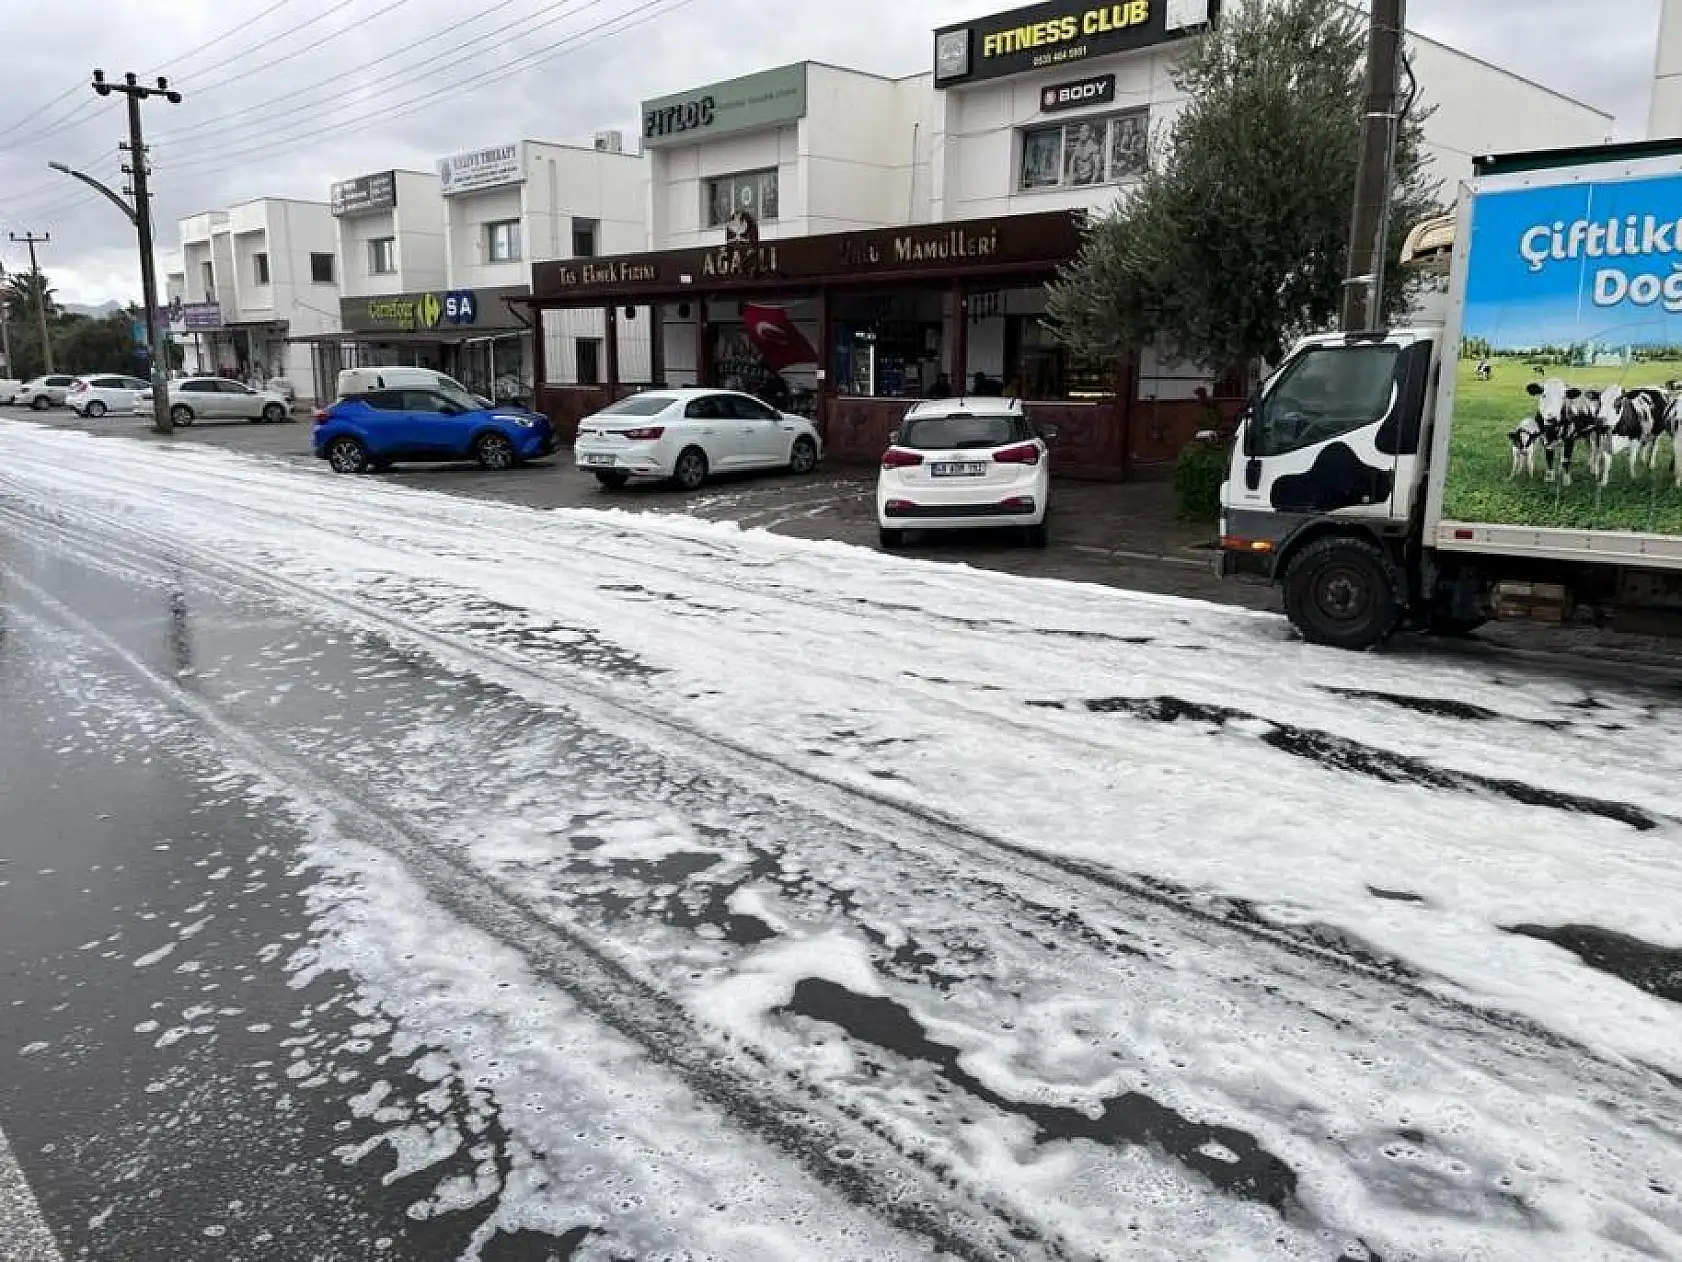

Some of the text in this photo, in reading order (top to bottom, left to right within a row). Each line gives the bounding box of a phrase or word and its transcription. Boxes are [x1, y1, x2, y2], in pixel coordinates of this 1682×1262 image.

[983, 16, 1078, 58] FITNESS
[1083, 1, 1149, 35] CLUB
[1059, 80, 1107, 102] BODY
[645, 95, 716, 138] FITLOC
[446, 296, 472, 317] SA
